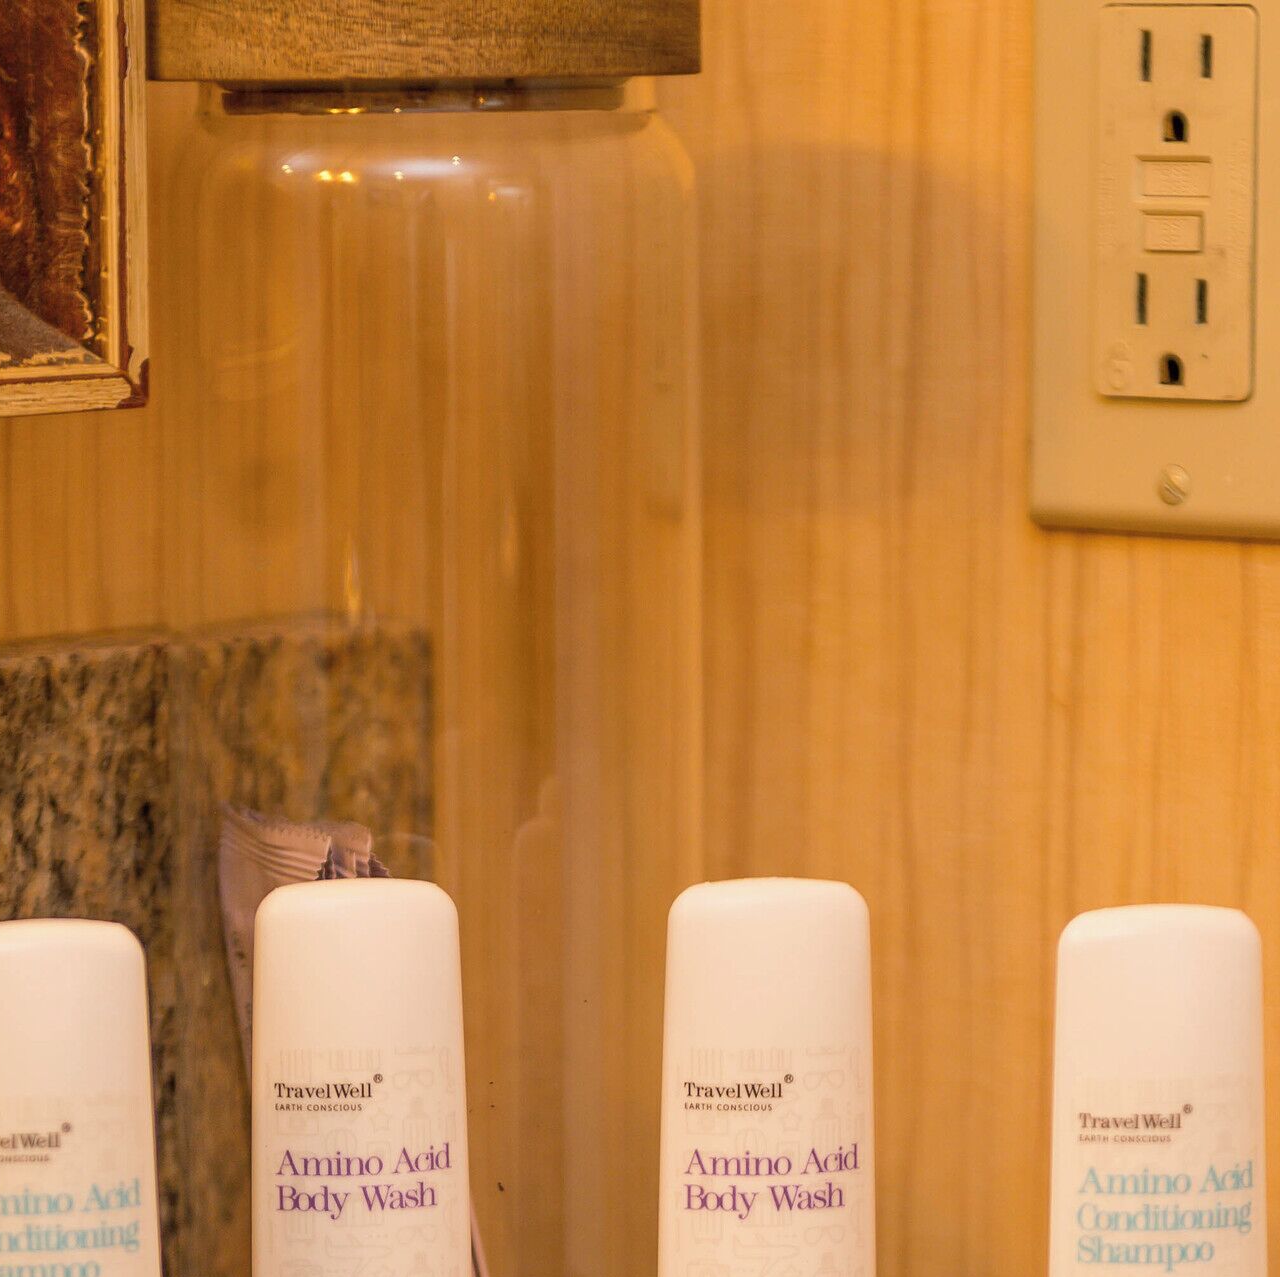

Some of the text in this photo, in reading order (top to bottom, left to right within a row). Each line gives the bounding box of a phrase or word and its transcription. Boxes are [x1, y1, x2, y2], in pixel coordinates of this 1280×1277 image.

[275, 1103, 363, 1112] EARTH CONSCIOUS
[684, 1102, 773, 1112] EARTH CONSCIOUS
[1114, 1134, 1171, 1143] CONSCIOUS
[276, 1142, 452, 1177] Amino Acid
[684, 1143, 860, 1177] Amino Acid
[81, 1177, 141, 1212] Acid
[1078, 1160, 1254, 1195] Amino Acid
[276, 1181, 438, 1220] Body Wash
[684, 1182, 845, 1220] Body Wash
[1076, 1202, 1252, 1234] Conditioning
[1077, 1235, 1215, 1273] Shampoo
